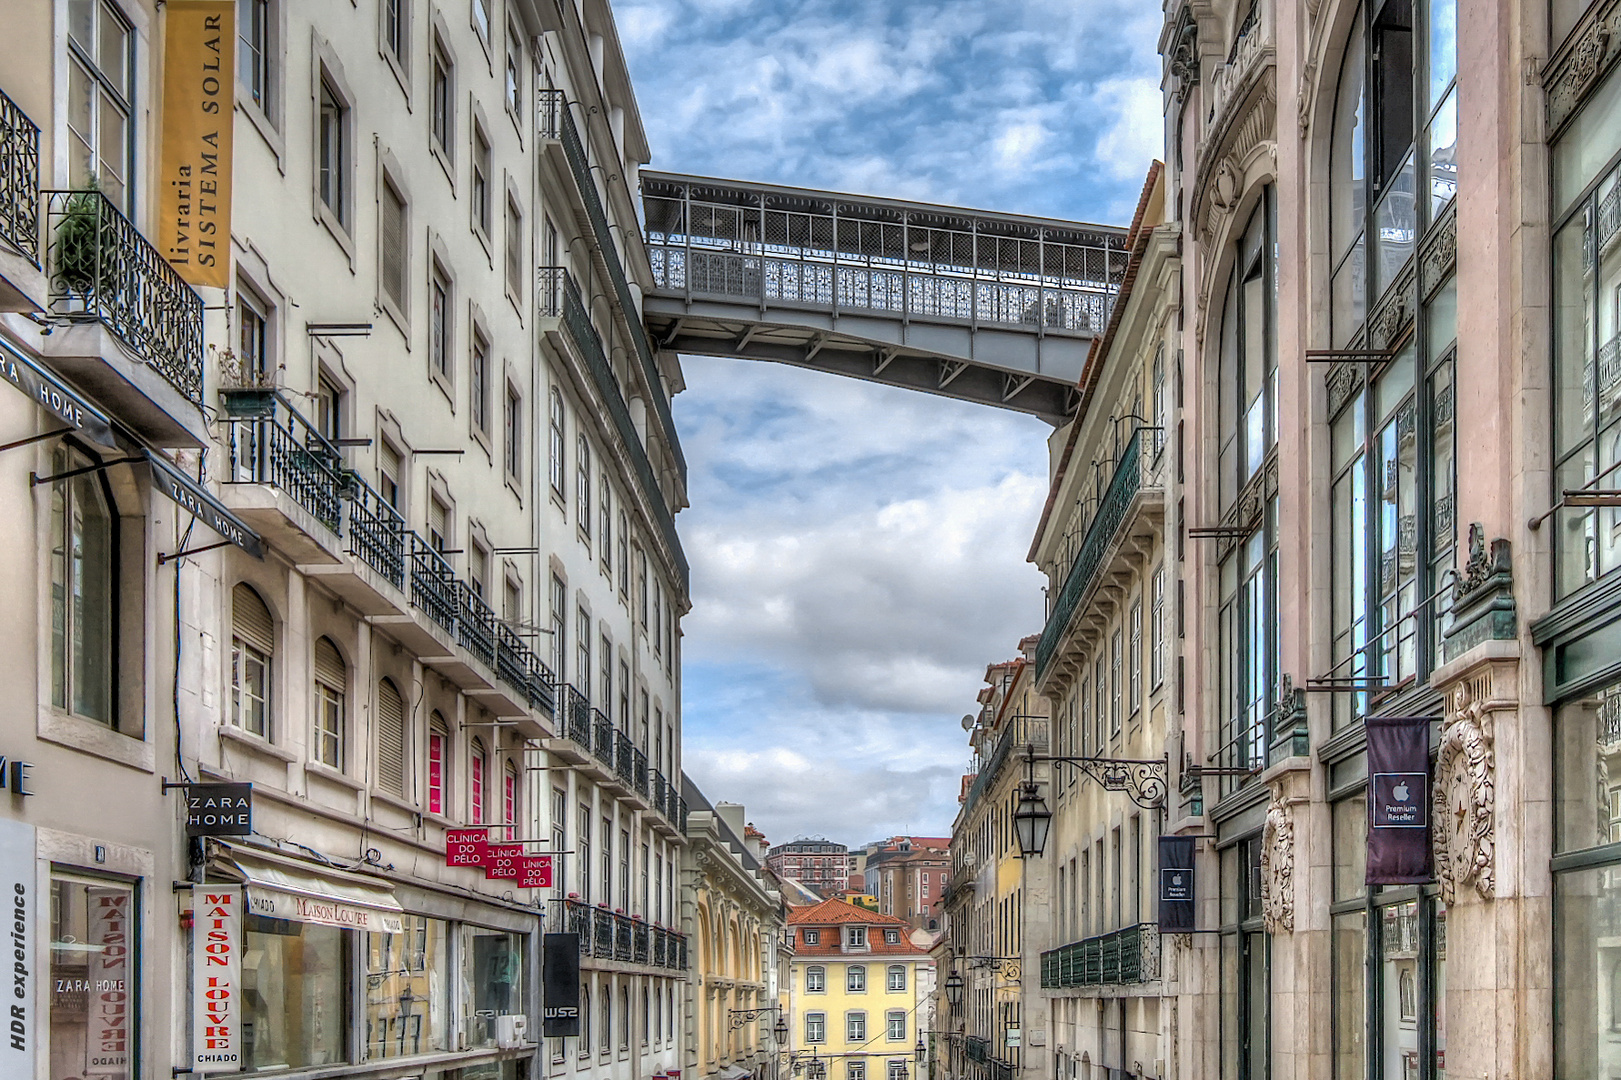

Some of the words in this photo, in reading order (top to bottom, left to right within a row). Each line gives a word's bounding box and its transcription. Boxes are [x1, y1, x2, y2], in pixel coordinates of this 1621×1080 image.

[202, 14, 221, 114] SOLAR
[198, 131, 218, 268] SISTEMA
[169, 164, 191, 265] livraria
[40, 383, 83, 428] HOME
[172, 482, 204, 518] ZARA
[214, 516, 244, 547] HOME
[190, 797, 249, 809] ZARA
[1385, 804, 1417, 812] Premium
[189, 814, 249, 825] HOME
[1387, 813, 1415, 821] Reseller
[446, 833, 488, 844] CLÍNICA
[459, 844, 475, 853] DO
[453, 854, 481, 864] PÊLO
[496, 859, 512, 867] DO
[522, 860, 551, 869] LÍNICA
[527, 869, 541, 877] DO
[523, 877, 546, 886] PÊLO
[296, 898, 334, 922] MAISON
[204, 894, 232, 966] MAISON
[56, 979, 91, 993] ZARA
[96, 979, 125, 993] HOME
[204, 977, 232, 1049] LOUVRE
[197, 1054, 238, 1063] CHIADO
